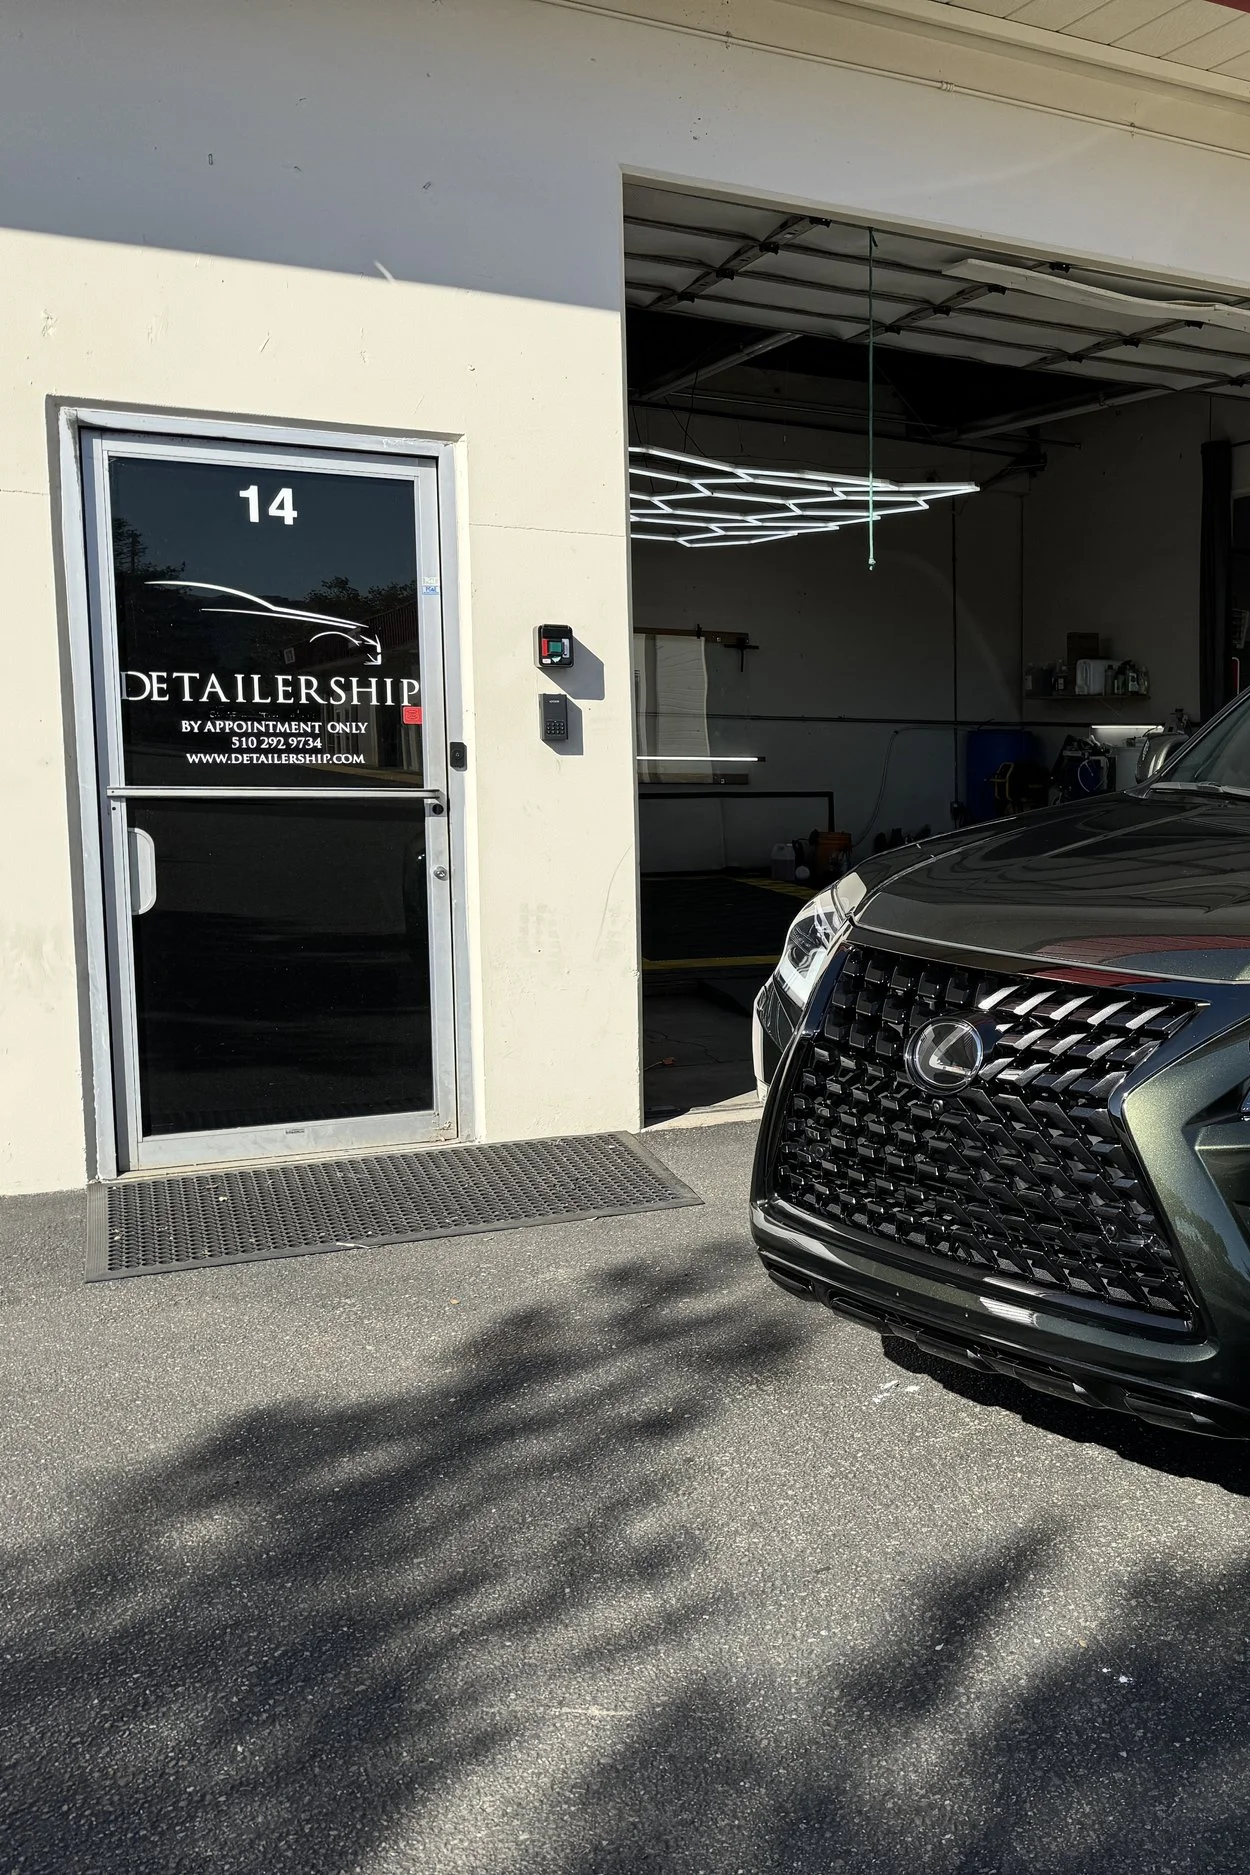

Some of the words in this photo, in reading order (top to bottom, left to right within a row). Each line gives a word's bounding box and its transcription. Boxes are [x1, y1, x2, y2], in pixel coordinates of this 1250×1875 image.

[239, 485, 298, 526] 14
[121, 671, 420, 707] DETAILERSHIP
[181, 720, 202, 733] BY
[203, 720, 323, 734] APPOINTMENT
[327, 722, 368, 734] ONLY
[231, 736, 257, 749] 510
[260, 736, 286, 749] 292
[288, 737, 323, 750] 9734
[186, 753, 366, 765] WWW.DETAILERSHIP.COM
